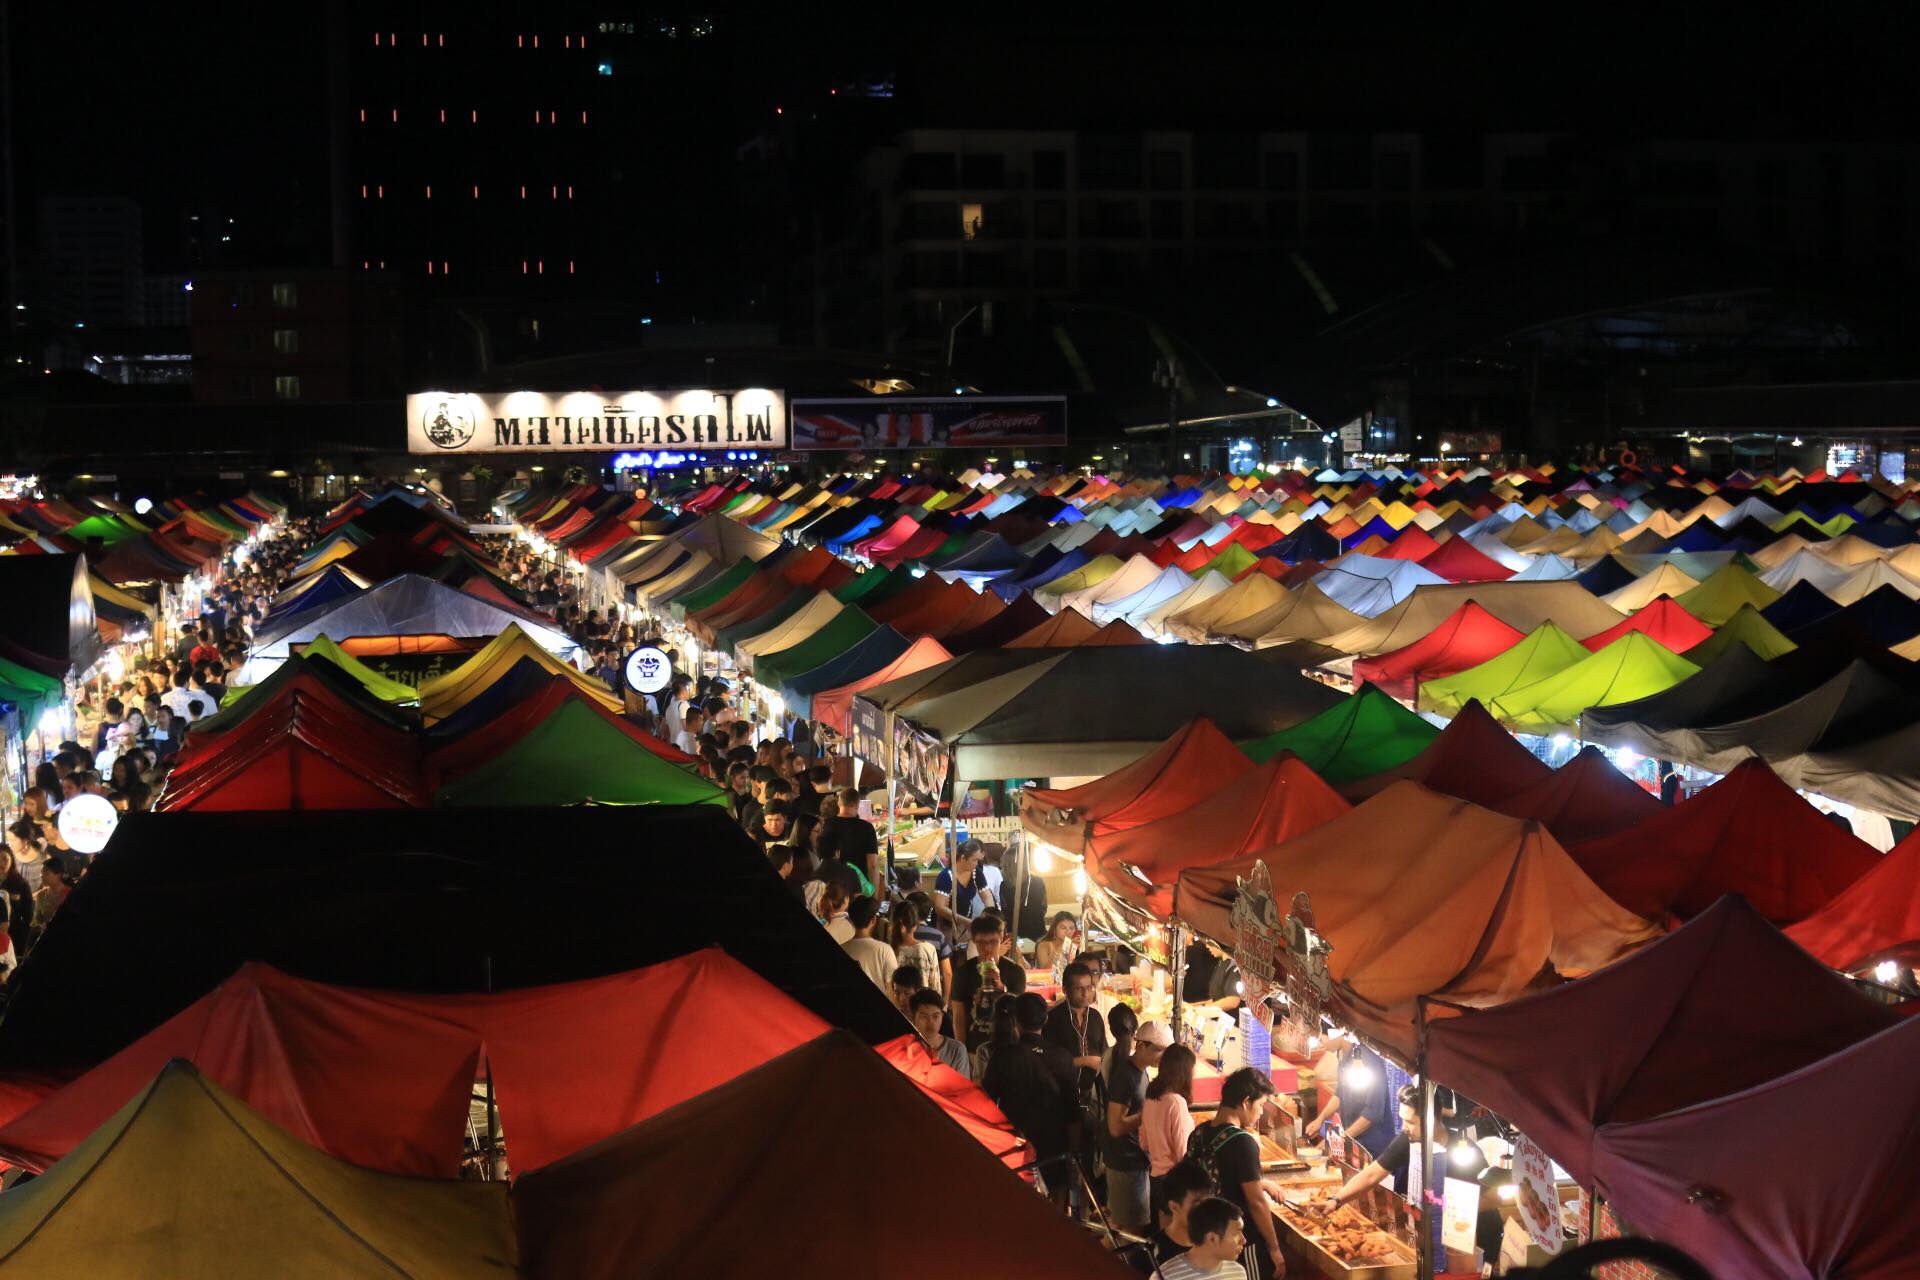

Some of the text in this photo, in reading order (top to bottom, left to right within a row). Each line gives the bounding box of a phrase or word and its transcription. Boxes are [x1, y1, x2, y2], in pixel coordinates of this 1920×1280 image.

[494, 394, 773, 446] ตลาดนัดรถไฟ
